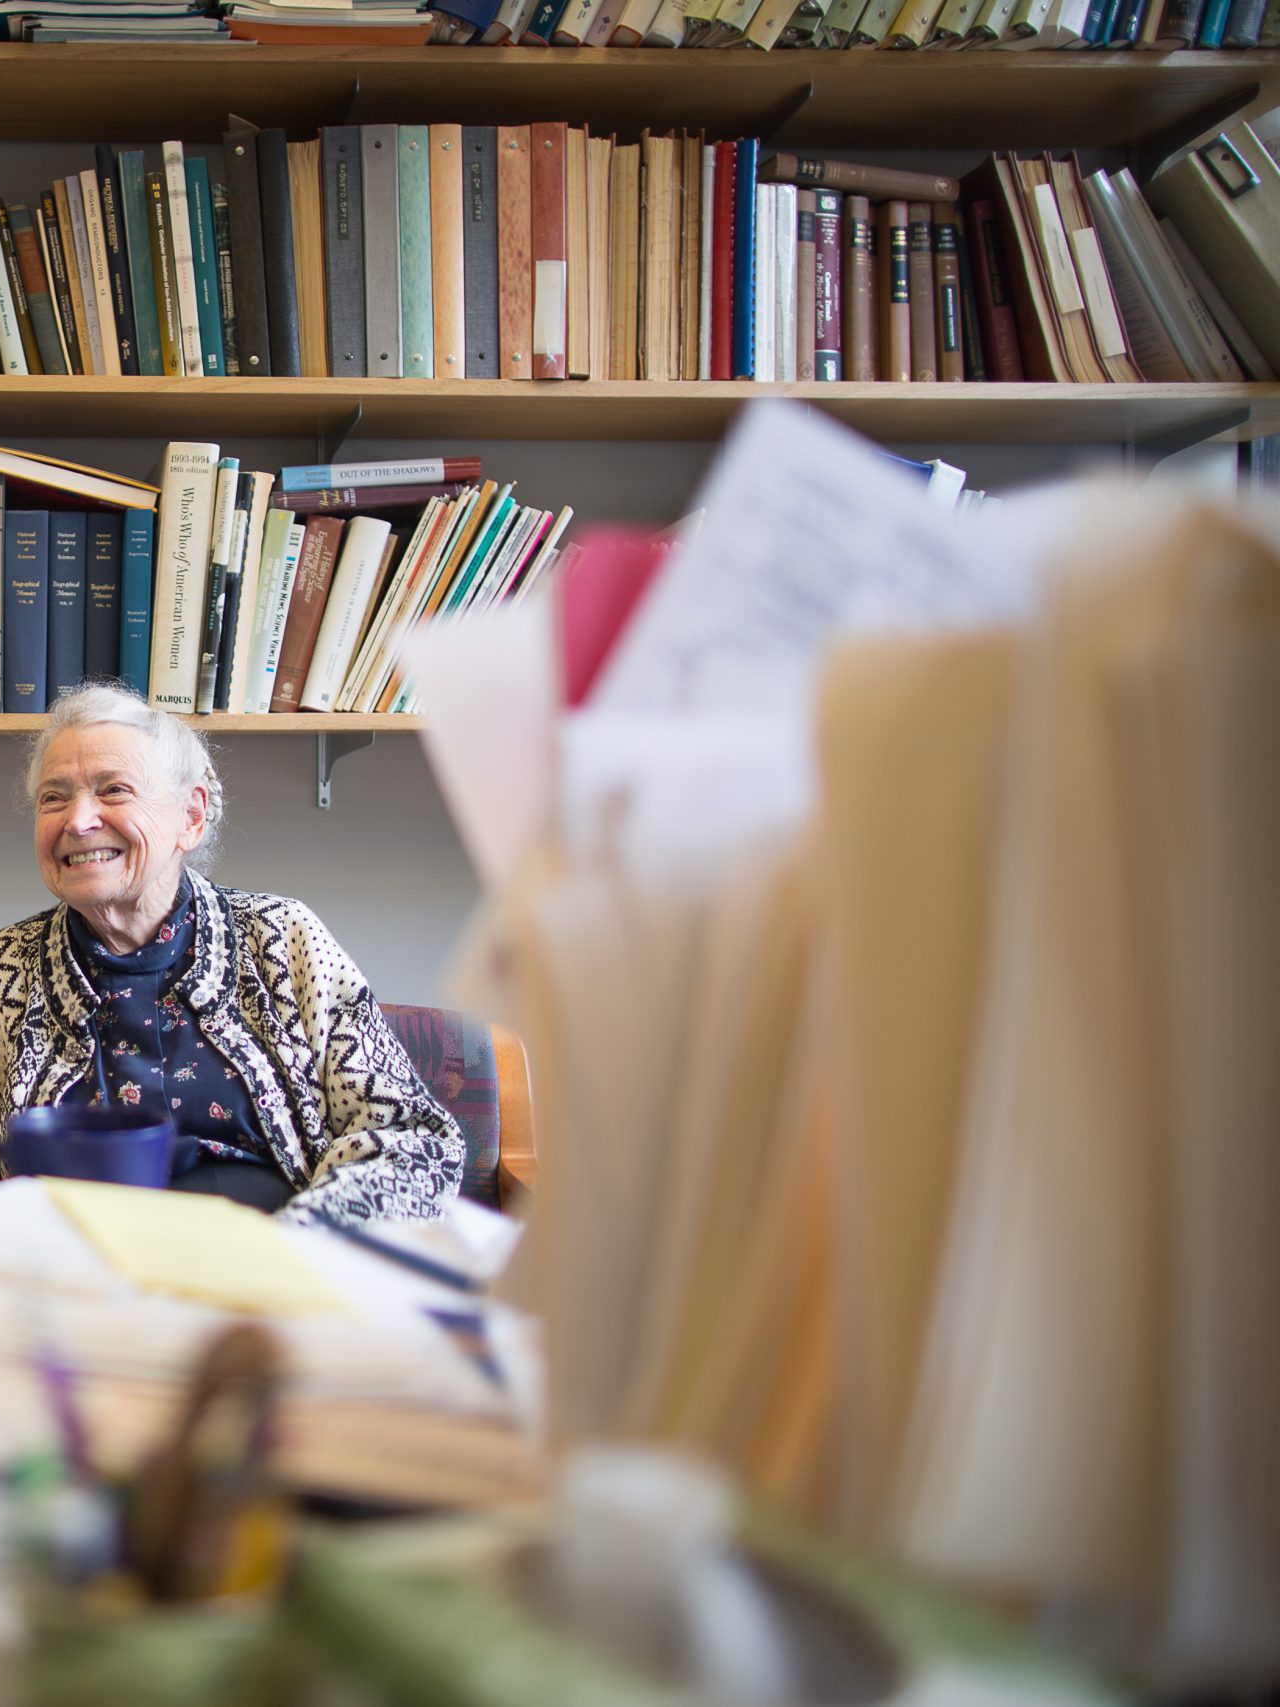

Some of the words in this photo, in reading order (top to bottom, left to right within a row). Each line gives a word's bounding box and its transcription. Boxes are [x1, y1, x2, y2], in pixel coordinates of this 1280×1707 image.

[88, 189, 97, 218] ORGANIC
[92, 222, 104, 281] SEMICONDUCTORS
[169, 465, 184, 475] 18th
[184, 465, 209, 475] edition
[170, 454, 210, 465] 1993-1994
[339, 470, 358, 479] OUT
[359, 469, 371, 477] OF
[373, 468, 390, 476] THE
[392, 465, 436, 475] SHADOWS
[180, 487, 195, 521] Who's
[178, 523, 193, 549] Who
[172, 551, 191, 567] of
[310, 530, 328, 570] Engineering
[324, 546, 333, 555] A
[310, 570, 318, 578] &
[317, 555, 331, 582] History
[351, 560, 366, 596] INVESTING
[173, 566, 189, 622] American
[304, 578, 316, 604] Science
[316, 582, 326, 591] of
[348, 598, 355, 606] IN
[208, 610, 216, 631] YEARS
[337, 608, 354, 648] INNOVATION
[169, 626, 185, 670] Women
[155, 694, 192, 705] MARQUIS
